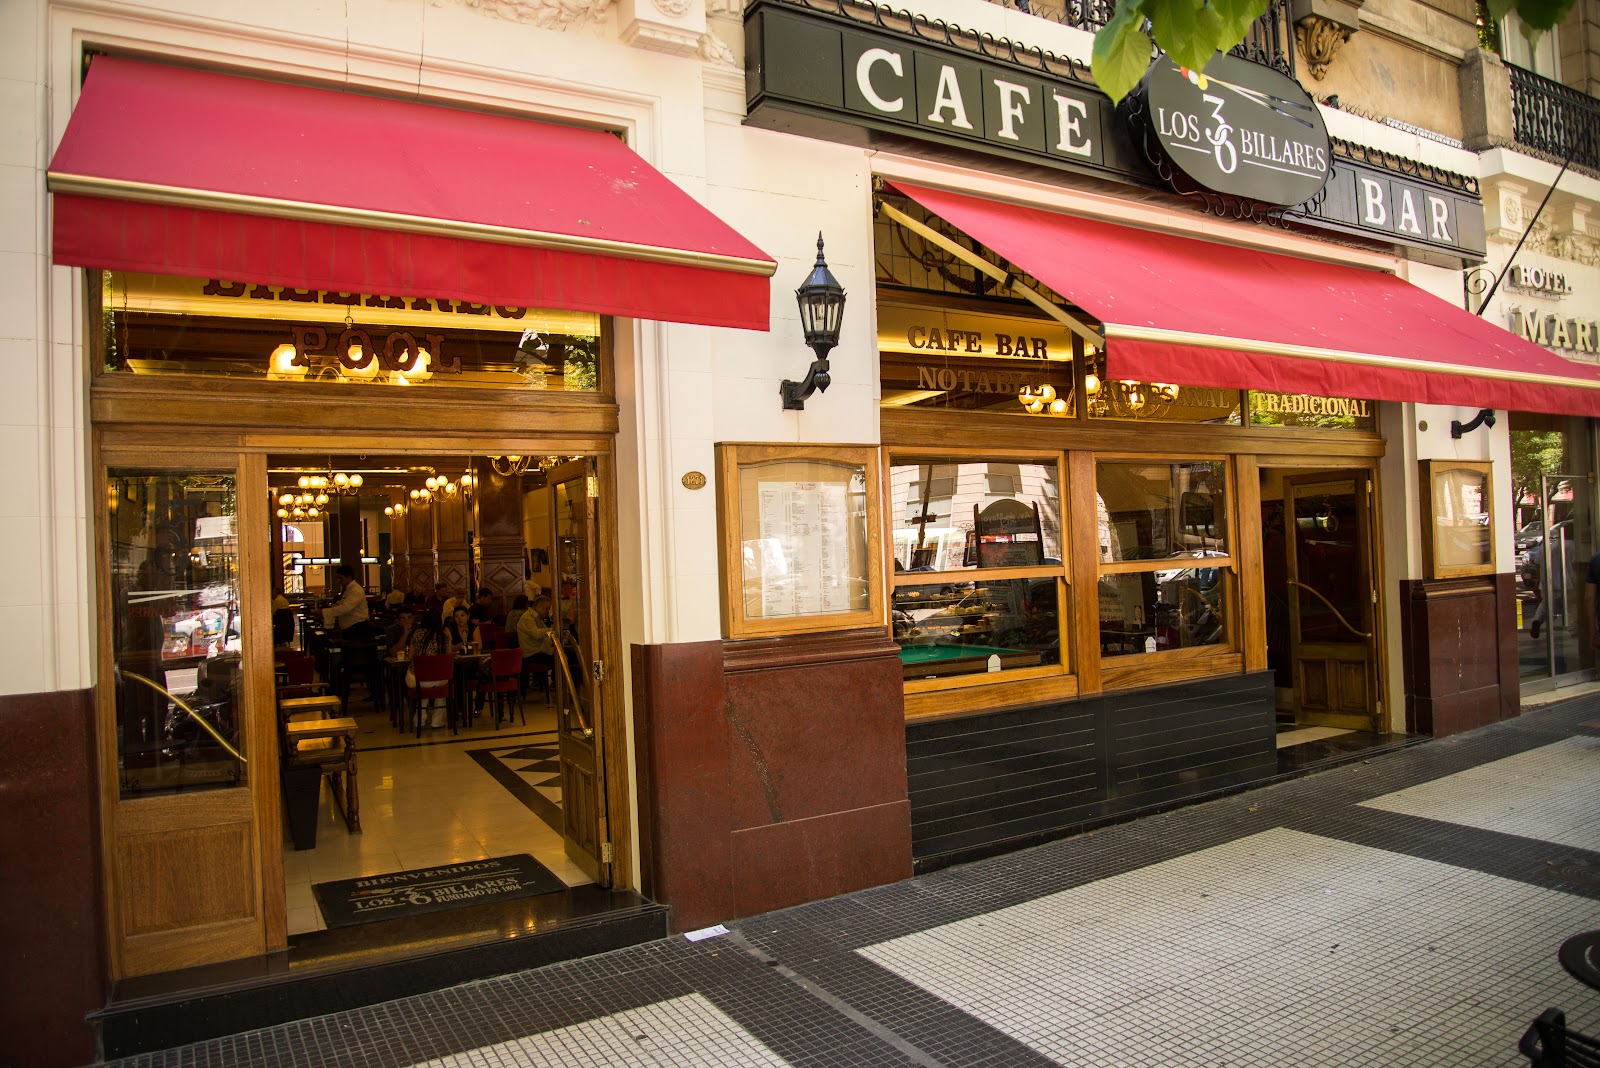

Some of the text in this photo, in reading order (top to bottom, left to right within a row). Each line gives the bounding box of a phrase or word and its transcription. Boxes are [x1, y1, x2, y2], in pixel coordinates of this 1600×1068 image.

[856, 48, 1453, 241] CAFE BAR
[1157, 107, 1200, 143] LOS
[1239, 128, 1327, 172] BILLARES
[1519, 265, 1572, 294] HOTEL
[907, 325, 1048, 359] CAFE BAR
[1519, 306, 1600, 355] MAR
[290, 325, 463, 374] POOL
[917, 365, 1045, 397] NOTABLE
[1100, 381, 1230, 409] ARTESANAL
[1253, 391, 1371, 418] TRADICIONAL
[355, 861, 501, 888] BIENVENIDOS
[355, 896, 396, 910] LOS
[431, 876, 519, 897] BILLARES
[434, 888, 485, 903] FUNDADO
[486, 886, 501, 896] EN
